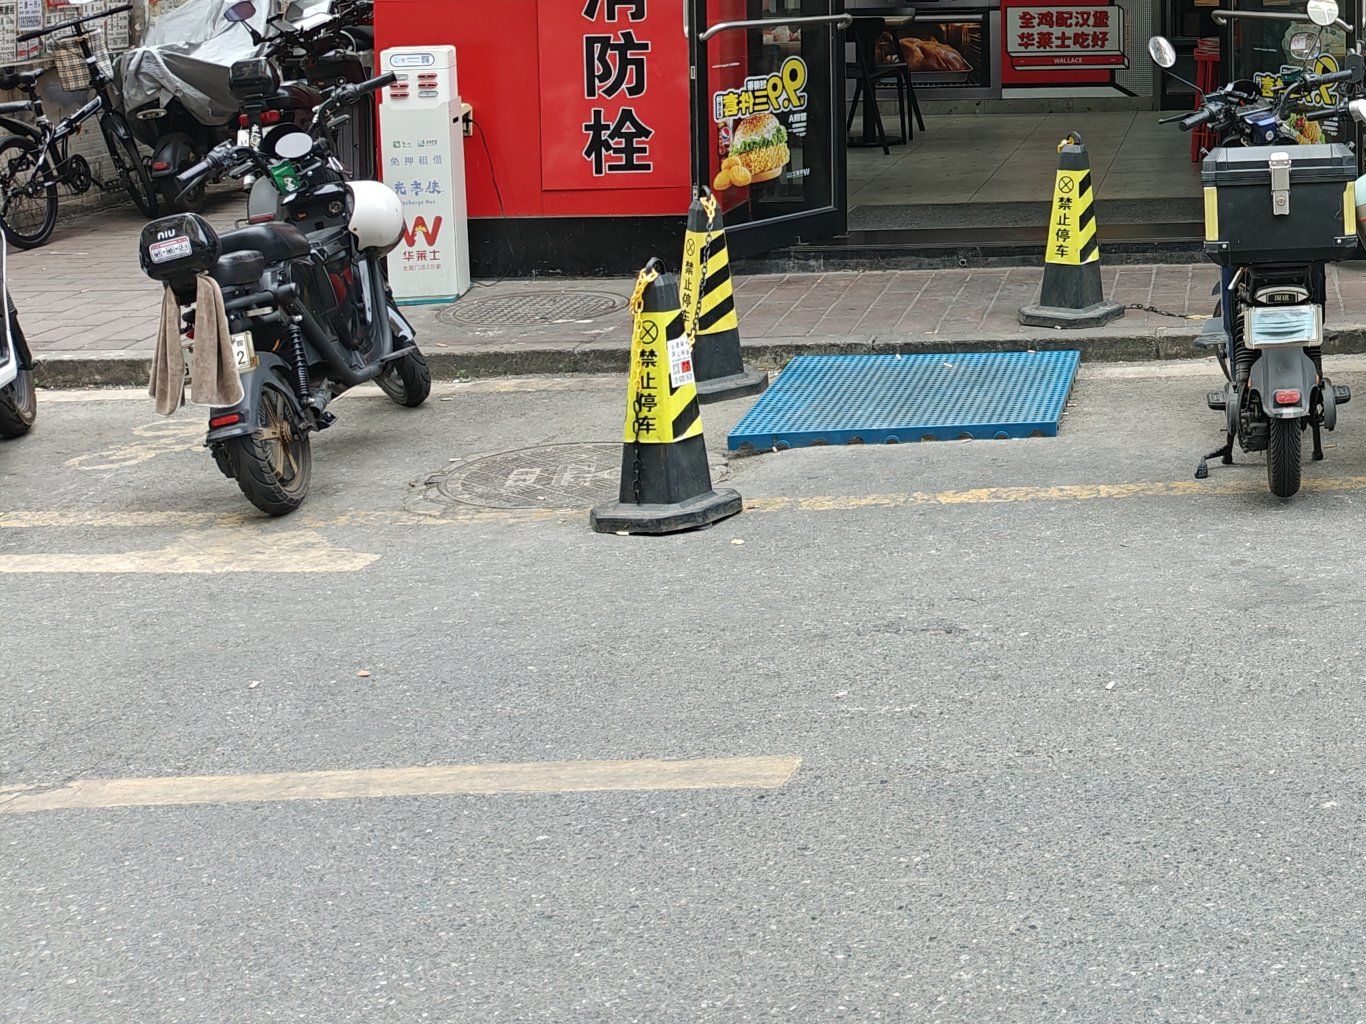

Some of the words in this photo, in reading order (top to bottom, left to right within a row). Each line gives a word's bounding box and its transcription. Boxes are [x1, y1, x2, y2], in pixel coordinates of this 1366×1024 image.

[1018, 10, 1110, 29] 全鸡配汉堡
[1017, 31, 1110, 50] 华莱士吃好
[390, 155, 442, 167] 免押租借
[1055, 196, 1073, 259] 禁止停车
[402, 249, 441, 263] 华莱士
[638, 354, 659, 436] 禁止停车
